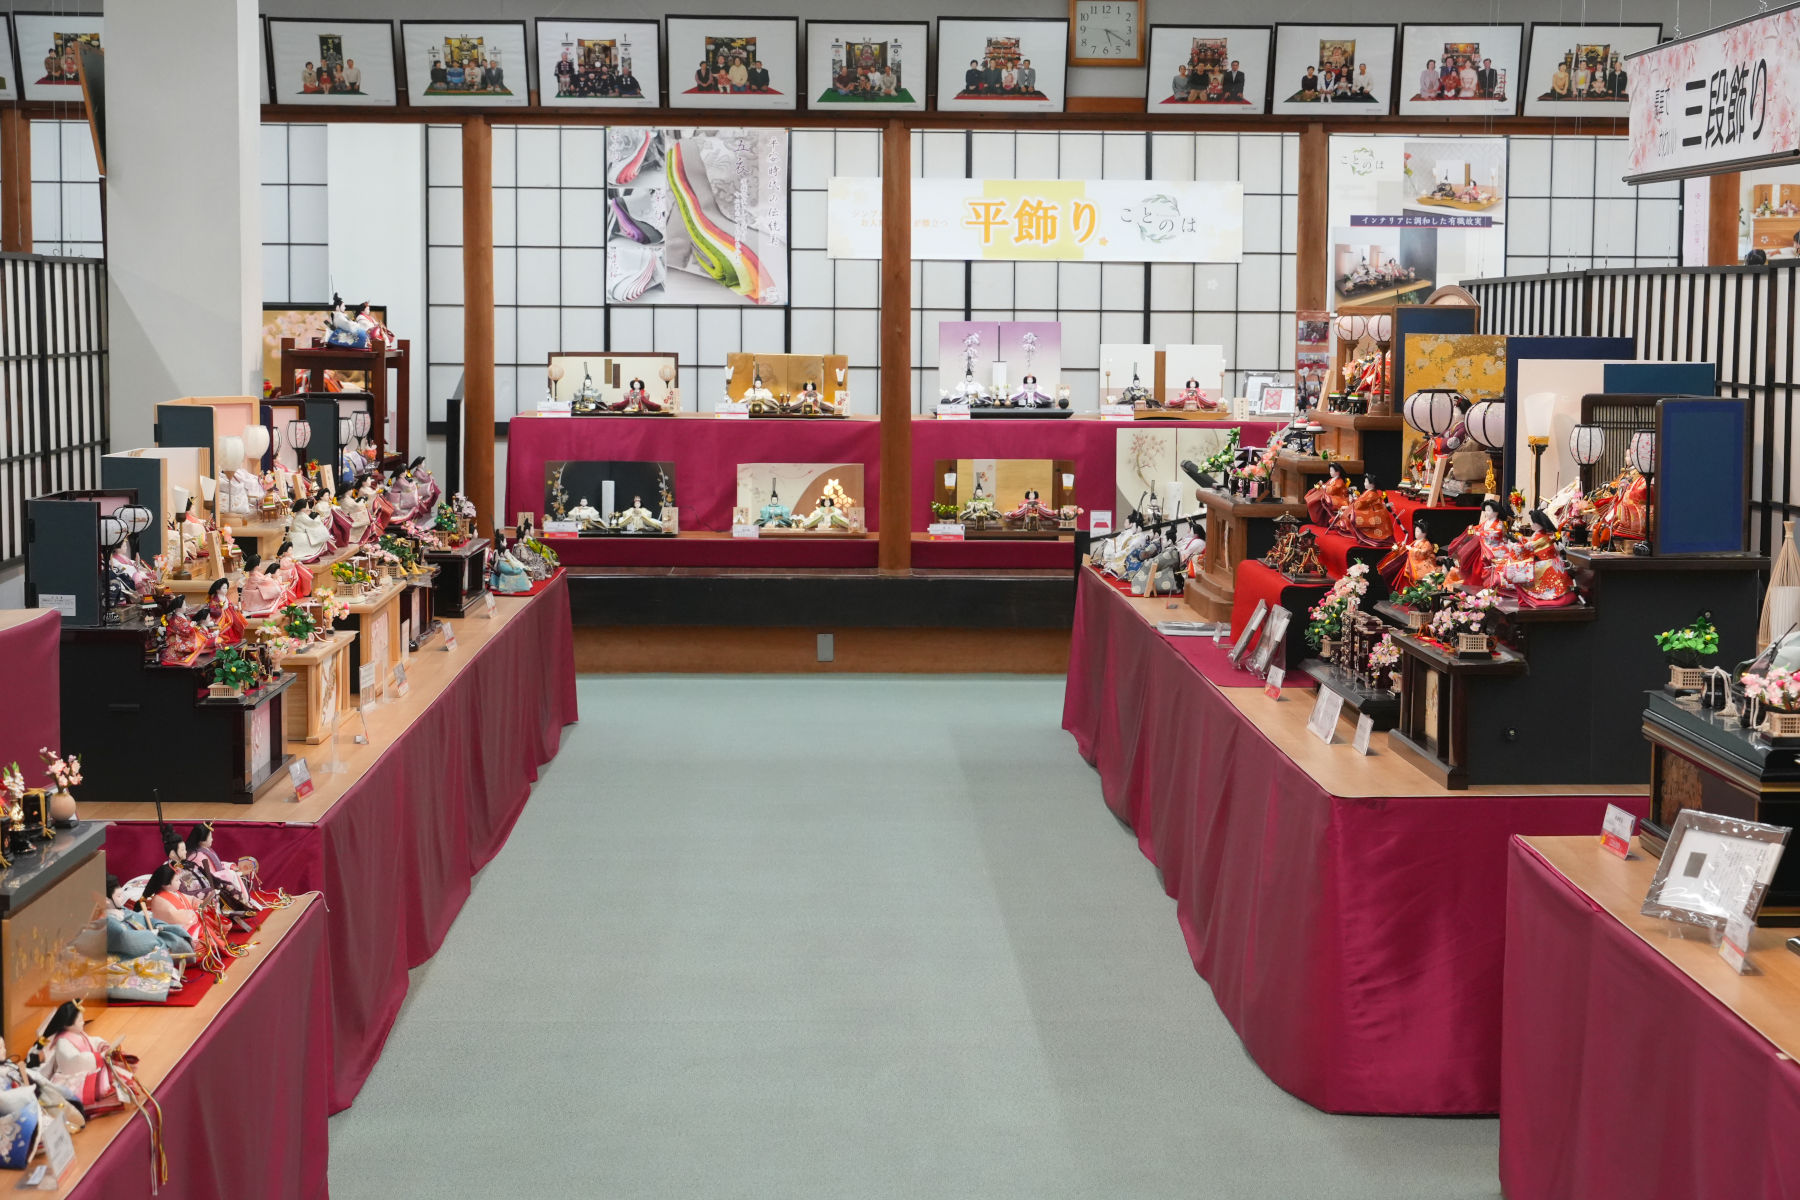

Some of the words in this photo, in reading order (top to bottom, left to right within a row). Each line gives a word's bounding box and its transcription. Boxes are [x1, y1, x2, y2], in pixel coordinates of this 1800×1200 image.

[1090, 6, 1097, 14] 11
[1102, 5, 1112, 14] 12
[1080, 13, 1089, 21] 10
[1126, 13, 1132, 22] 2
[1126, 26, 1132, 35] 3
[1090, 46, 1097, 55] 7
[1115, 46, 1121, 54] 5
[1682, 58, 1768, 150] 三段飾り
[965, 198, 1097, 244] 平飾り
[1120, 206, 1197, 233] ことのは
[1361, 216, 1482, 226] インテリアに調和した有職故実
